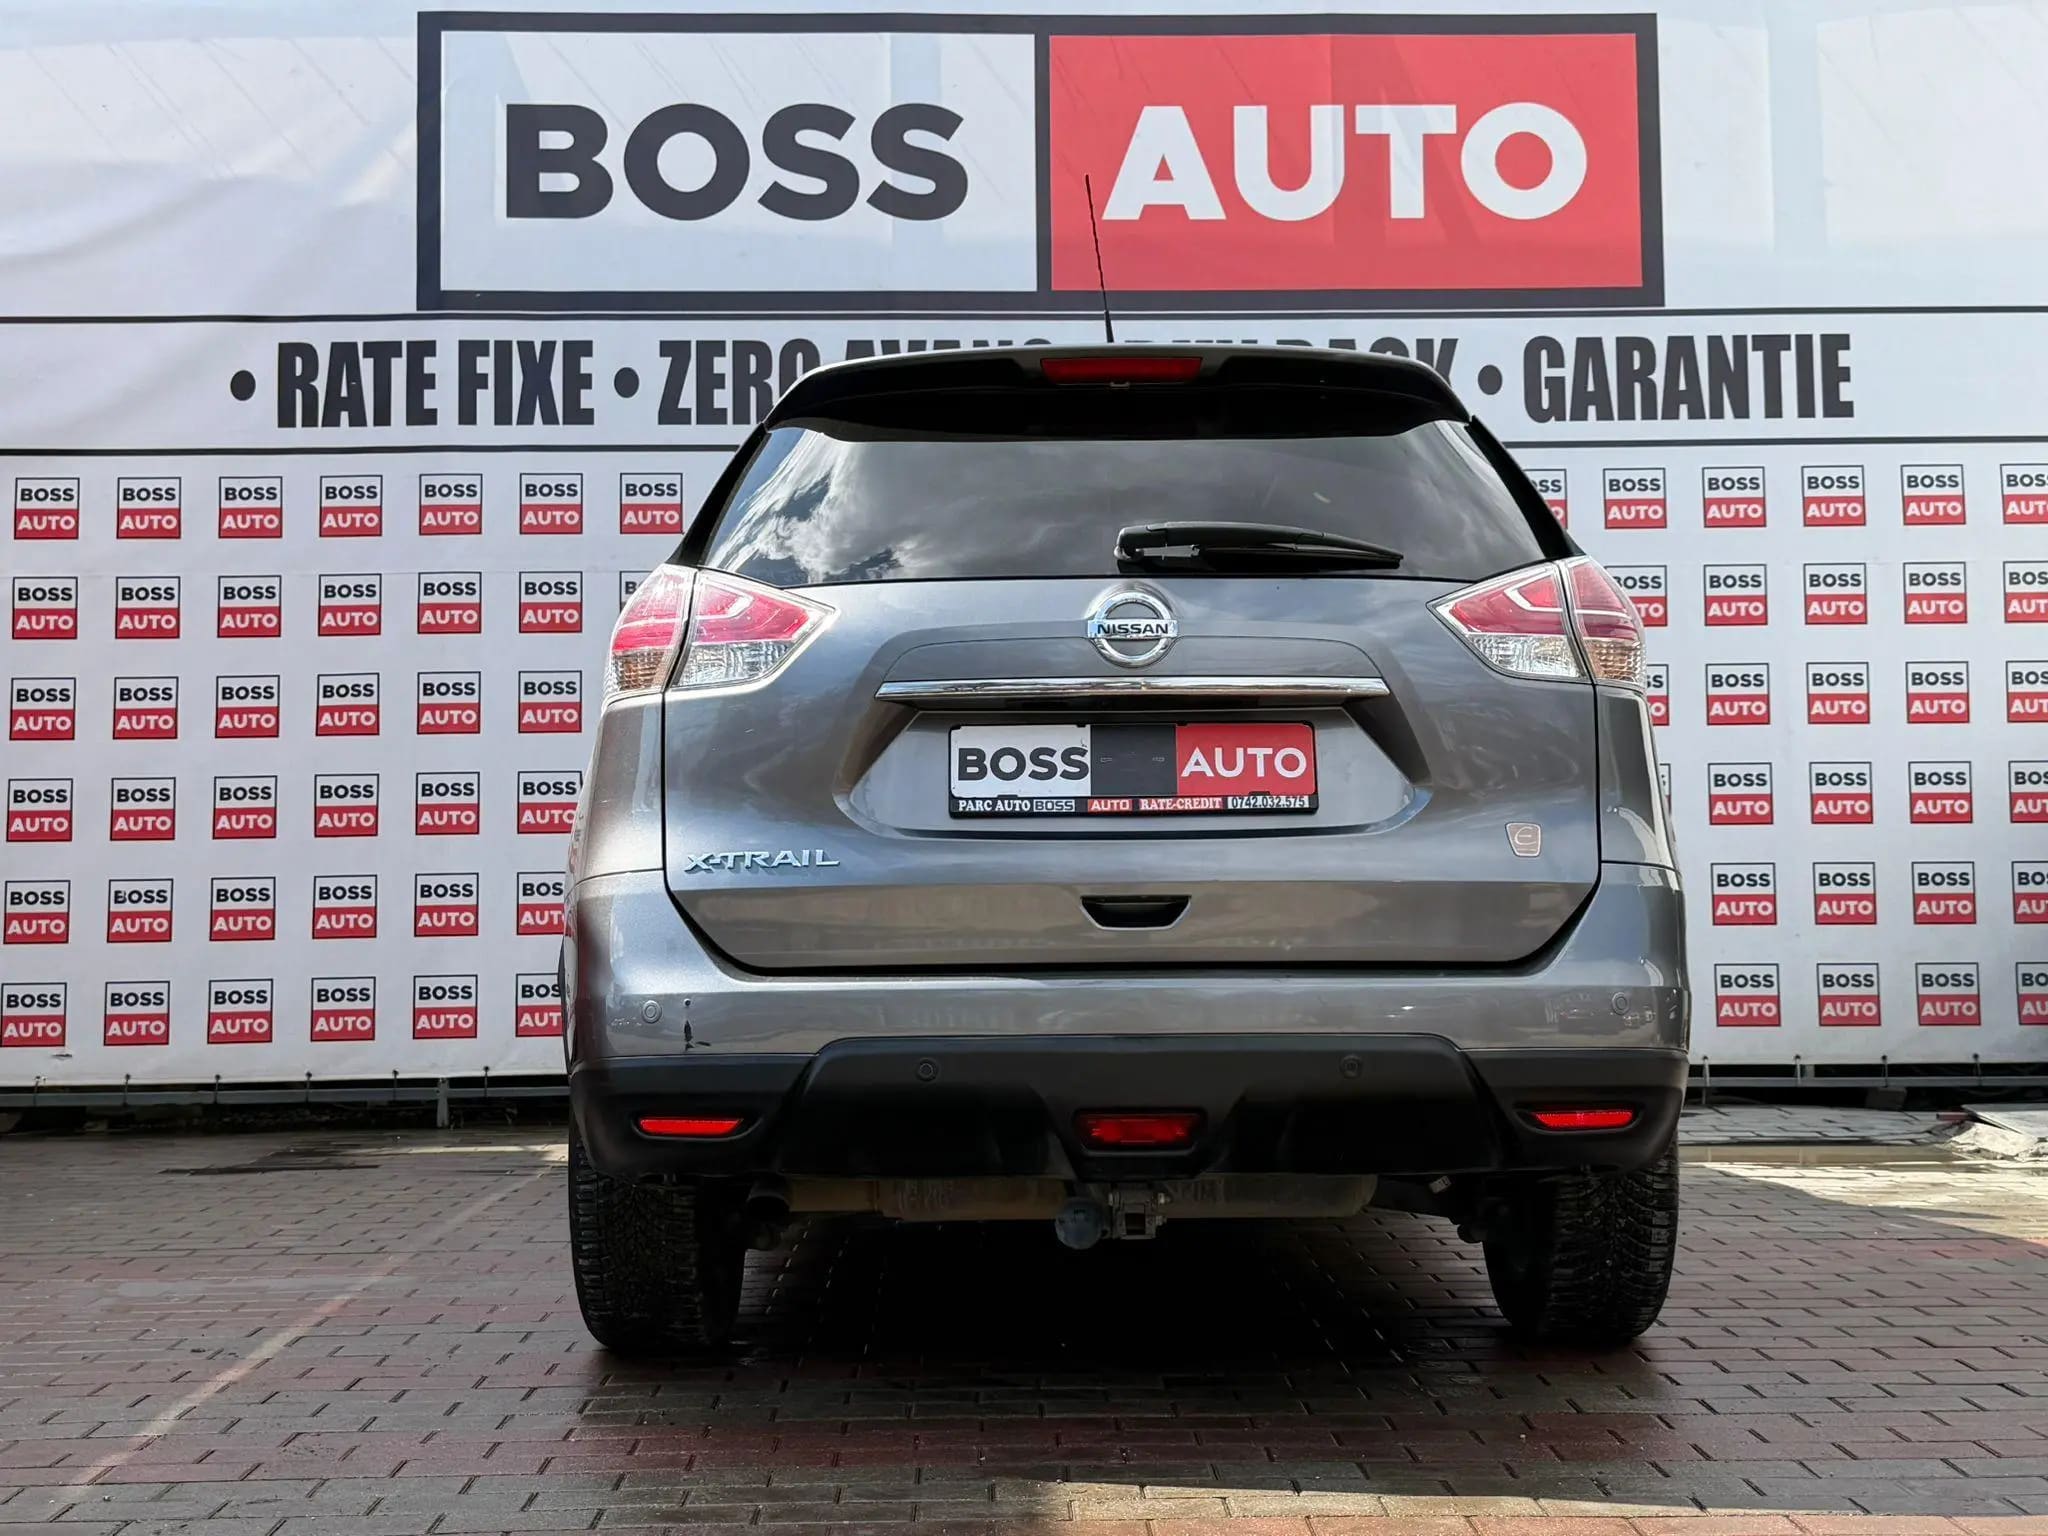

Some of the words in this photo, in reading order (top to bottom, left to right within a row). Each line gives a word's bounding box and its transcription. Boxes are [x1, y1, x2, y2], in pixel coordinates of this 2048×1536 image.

[506, 103, 968, 221] BOSS
[1101, 102, 1587, 221] AUTO
[277, 341, 438, 428] RATE
[458, 340, 594, 426] FIXE
[1523, 334, 1855, 423] GARANTIE
[1610, 478, 1661, 492] BOSS
[1709, 477, 1760, 491] BOSS
[1808, 475, 1860, 489] BOSS
[1908, 474, 1959, 488] BOSS
[2006, 473, 2048, 487] BOS
[21, 487, 75, 502] BOSS
[123, 487, 176, 502] BOSS
[225, 486, 278, 501] BOSS
[326, 485, 378, 500] BOSS
[425, 483, 478, 498] BOSS
[526, 483, 578, 497] BOSS
[625, 483, 678, 497] BOSS
[1608, 504, 1663, 521] AUTO
[1707, 503, 1763, 519] AUTO
[1806, 502, 1863, 518] AUTO
[1907, 500, 1963, 517] AUTO
[2005, 500, 2048, 516] AUT
[19, 515, 75, 530] AUTO
[120, 514, 177, 530] AUTO
[223, 514, 279, 529] AUTO
[323, 512, 378, 528] AUTO
[423, 511, 478, 526] AUTO
[523, 510, 579, 526] AUTO
[623, 510, 680, 525] AUTO
[1710, 574, 1762, 589] BOSS
[1810, 573, 1862, 588] BOSS
[1910, 572, 1961, 586] BOSS
[2008, 571, 2048, 586] BOS
[18, 587, 73, 602] BOSS
[122, 586, 176, 601] BOSS
[224, 585, 276, 600] BOSS
[325, 583, 377, 599] BOSS
[424, 581, 477, 596] BOSS
[525, 581, 578, 596] BOSS
[1636, 602, 1664, 618] TO
[1708, 601, 1764, 617] AUTO
[1808, 600, 1864, 616] AUTO
[1908, 599, 1964, 616] AUTO
[2008, 598, 2048, 614] AUT
[17, 615, 73, 630] AUTO
[120, 614, 176, 630] AUTO
[222, 613, 277, 629] AUTO
[322, 611, 377, 627] AUTO
[421, 609, 477, 625] AUTO
[523, 608, 579, 624] AUTO
[1097, 623, 1169, 635] NISSAN
[1712, 673, 1764, 688] BOSS
[1813, 672, 1864, 687] BOSS
[1912, 671, 1964, 686] BOSS
[2011, 671, 2048, 685] BOS
[17, 687, 71, 703] BOSS
[120, 687, 173, 702] BOSS
[222, 685, 275, 701] BOSS
[323, 683, 375, 699] BOSS
[423, 681, 476, 697] BOSS
[524, 680, 577, 696] BOSS
[1710, 700, 1766, 717] AUTO
[1811, 699, 1867, 715] AUTO
[1910, 699, 1966, 715] AUTO
[2010, 698, 2048, 714] AUT
[14, 716, 71, 731] AUTO
[117, 715, 174, 730] AUTO
[219, 713, 275, 729] AUTO
[320, 711, 375, 727] AUTO
[421, 709, 476, 725] AUTO
[522, 708, 578, 724] AUTO
[957, 747, 1090, 782] BOSS
[1181, 747, 1307, 778] AUTO
[1714, 773, 1767, 788] BOSS
[1816, 772, 1867, 787] BOSS
[1915, 771, 1967, 786] BOSS
[14, 788, 68, 804] BOSS
[117, 787, 171, 803] BOSS
[220, 785, 272, 802] BOSS
[320, 784, 375, 799] BOSS
[422, 782, 475, 798] BOSS
[523, 781, 575, 796] BOSS
[958, 799, 993, 812] PARC
[995, 799, 1031, 812] AUTO
[1034, 801, 1074, 811] BOSS
[1090, 799, 1130, 811] AUTO
[1713, 800, 1769, 816] AUTO
[1815, 799, 1870, 815] AUTO
[1914, 799, 1969, 815] AUTO
[11, 817, 68, 832] AUTO
[115, 816, 171, 831] AUTO
[217, 814, 272, 830] AUTO
[319, 812, 374, 828] AUTO
[420, 810, 475, 826] AUTO
[684, 849, 840, 872] X-TRAIL
[1717, 873, 1771, 888] BOSS
[1819, 872, 1871, 887] BOSS
[1919, 871, 1970, 887] BOSS
[2018, 871, 2048, 886] BO
[114, 889, 168, 905] BOSS
[217, 887, 271, 903] BOSS
[319, 885, 372, 901] BOSS
[421, 883, 474, 899] BOSS
[522, 882, 564, 897] BOS
[10, 890, 65, 906] BOSS
[1716, 901, 1773, 916] AUTO
[1818, 900, 1872, 916] AUTO
[1918, 900, 1972, 915] AUTO
[112, 917, 168, 933] AUTO
[214, 916, 271, 931] AUTO
[317, 913, 373, 929] AUTO
[418, 911, 474, 927] AUTO
[520, 910, 565, 926] AUT
[8, 919, 65, 935] AUTO
[1721, 974, 1775, 989] BOSS
[1823, 973, 1875, 988] BOSS
[1923, 972, 1975, 988] BOSS
[2022, 972, 2048, 987] BO
[111, 991, 165, 1007] BOSS
[214, 989, 268, 1005] BOSS
[317, 987, 371, 1003] BOSS
[419, 985, 473, 1001] BOSS
[521, 984, 561, 998] BOS
[7, 993, 62, 1009] BOSS
[1922, 1001, 1976, 1017] AUTO
[2022, 1001, 2048, 1016] AU
[1720, 1002, 1776, 1017] AUTO
[1823, 1002, 1876, 1017] AUTO
[212, 1018, 268, 1034] AUTO
[315, 1016, 371, 1032] AUTO
[417, 1013, 473, 1030] AUTO
[519, 1012, 562, 1027] AUT
[4, 1022, 61, 1038] AUTO
[108, 1020, 165, 1036] AUTO
